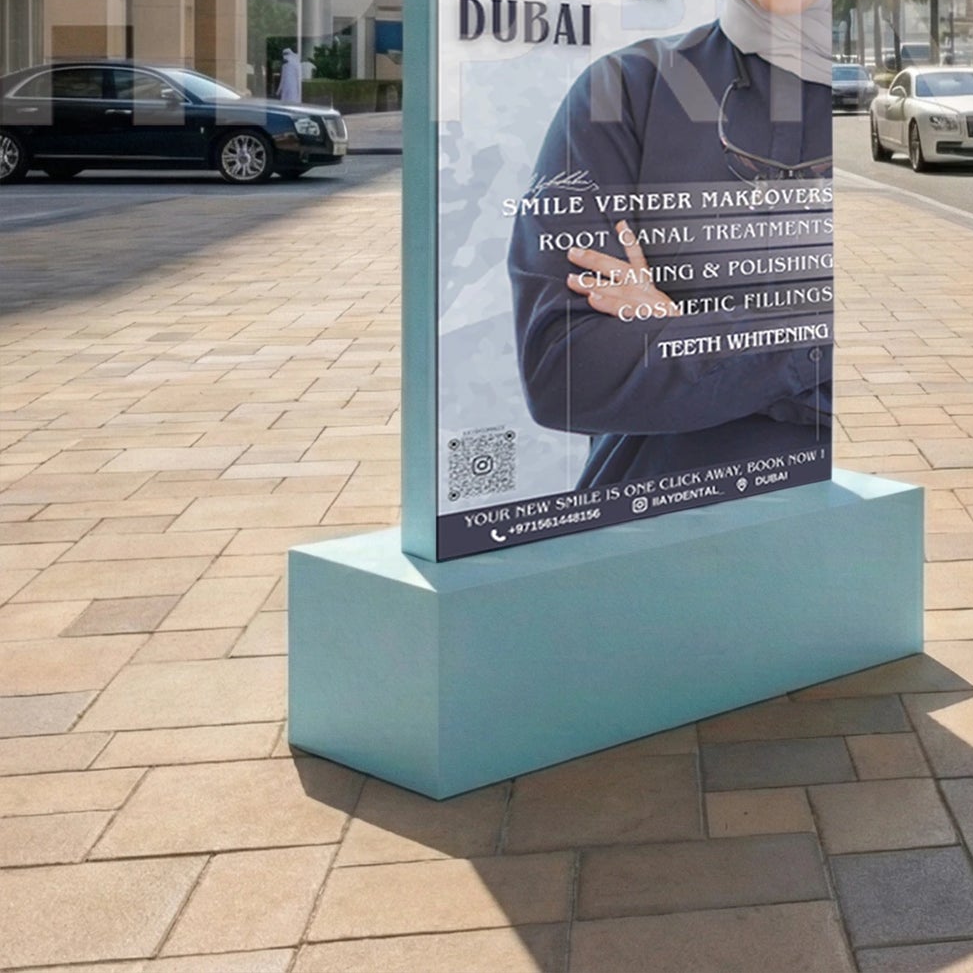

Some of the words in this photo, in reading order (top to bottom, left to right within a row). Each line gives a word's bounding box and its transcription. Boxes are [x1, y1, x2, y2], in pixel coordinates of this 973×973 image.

[502, 196, 584, 216] SMILE
[595, 192, 692, 213] VENEER
[701, 187, 833, 208] MAKEOVERS
[539, 230, 609, 252] ROOT
[618, 226, 695, 247] CANAL
[702, 218, 833, 241] TREATMENTS
[578, 264, 694, 290] CLEANING
[702, 262, 720, 278] &
[728, 253, 833, 276] POLISHING
[618, 295, 736, 322] COSMETIC
[744, 286, 833, 310] FILLINGS
[658, 335, 721, 358] TEETH
[727, 323, 829, 351] WHITENING
[464, 508, 511, 528] YOUR
[515, 502, 551, 518] NEW
[555, 491, 602, 511] SMILE
[605, 487, 620, 501] IS
[624, 480, 655, 496] ONE
[658, 472, 701, 491] CLICK
[747, 456, 785, 474] BOOK
[787, 451, 817, 466] NOW
[754, 471, 789, 487] DUBAI
